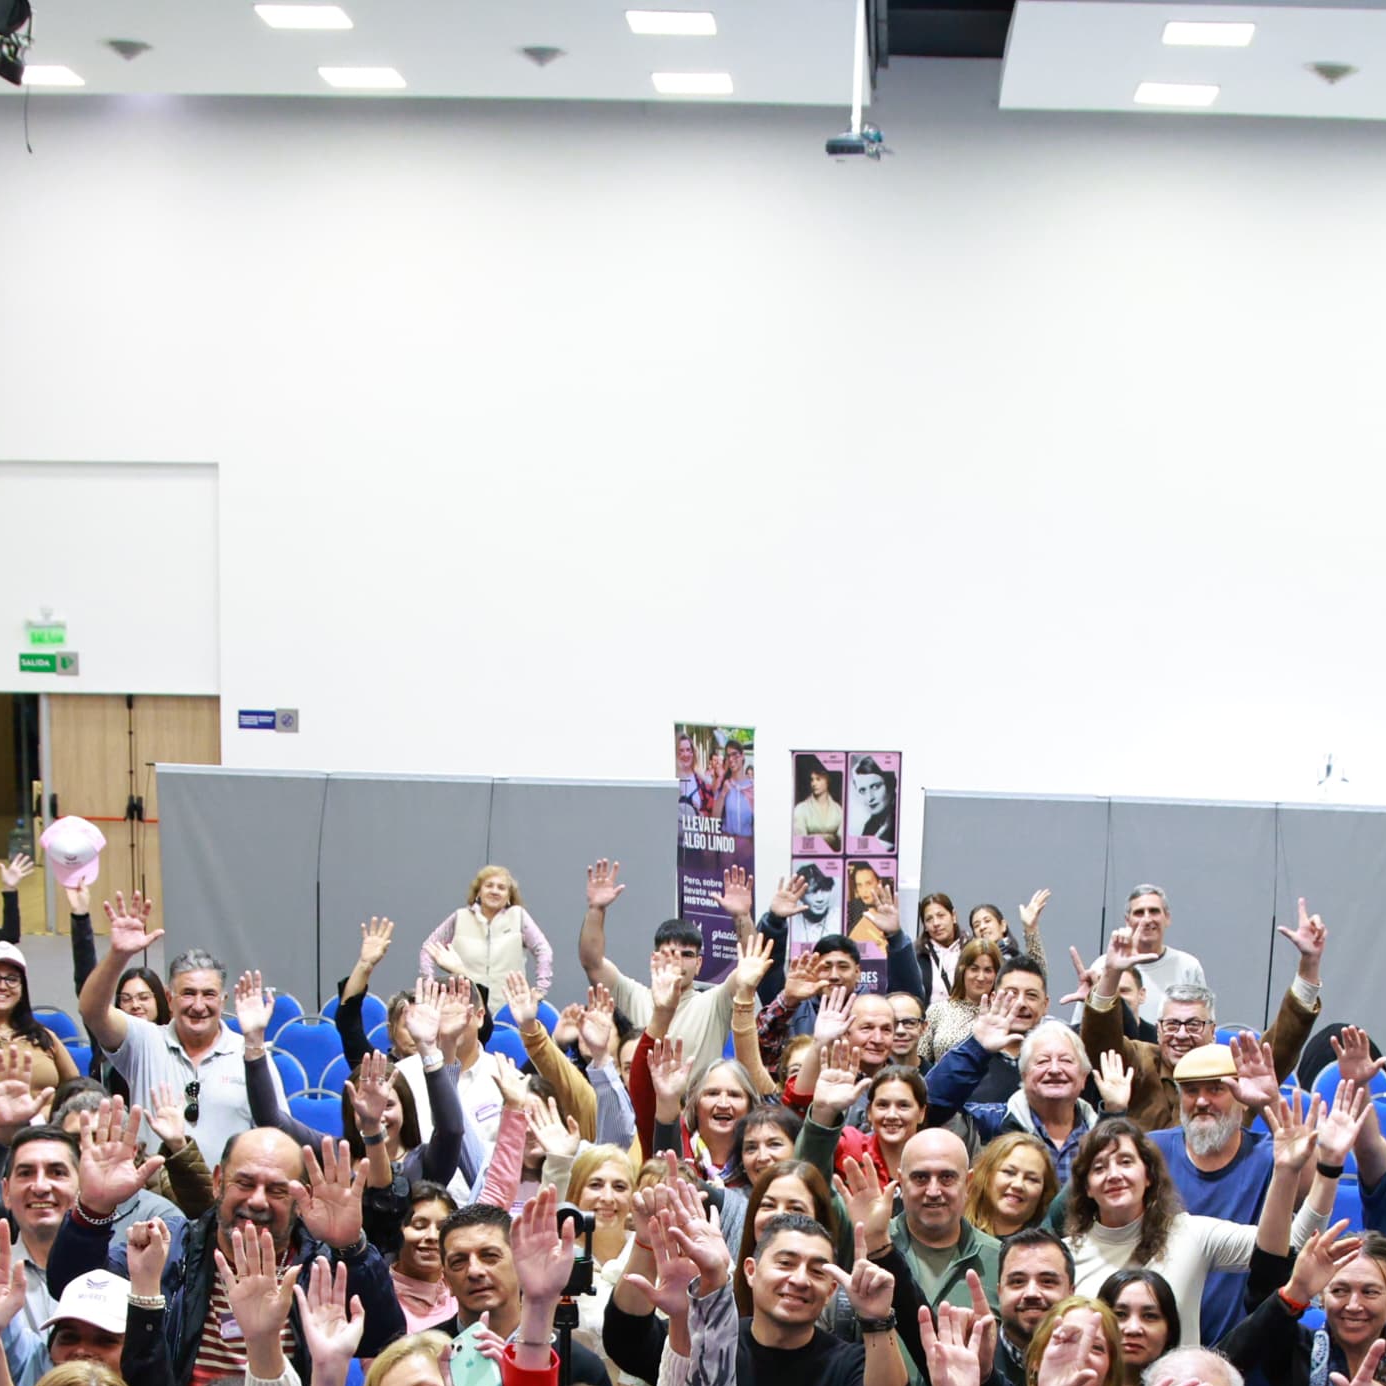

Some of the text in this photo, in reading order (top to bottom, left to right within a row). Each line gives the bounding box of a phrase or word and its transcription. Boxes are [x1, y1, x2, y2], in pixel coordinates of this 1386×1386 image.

[20, 658, 51, 667] SALIDA
[682, 814, 722, 834] LLEVATE
[683, 832, 735, 853] ALGO LINDO
[684, 875, 723, 888] Pero, sobre
[684, 885, 707, 896] llevate
[683, 896, 719, 908] HISTORIA
[712, 930, 737, 942] gracia
[858, 971, 878, 984] RES
